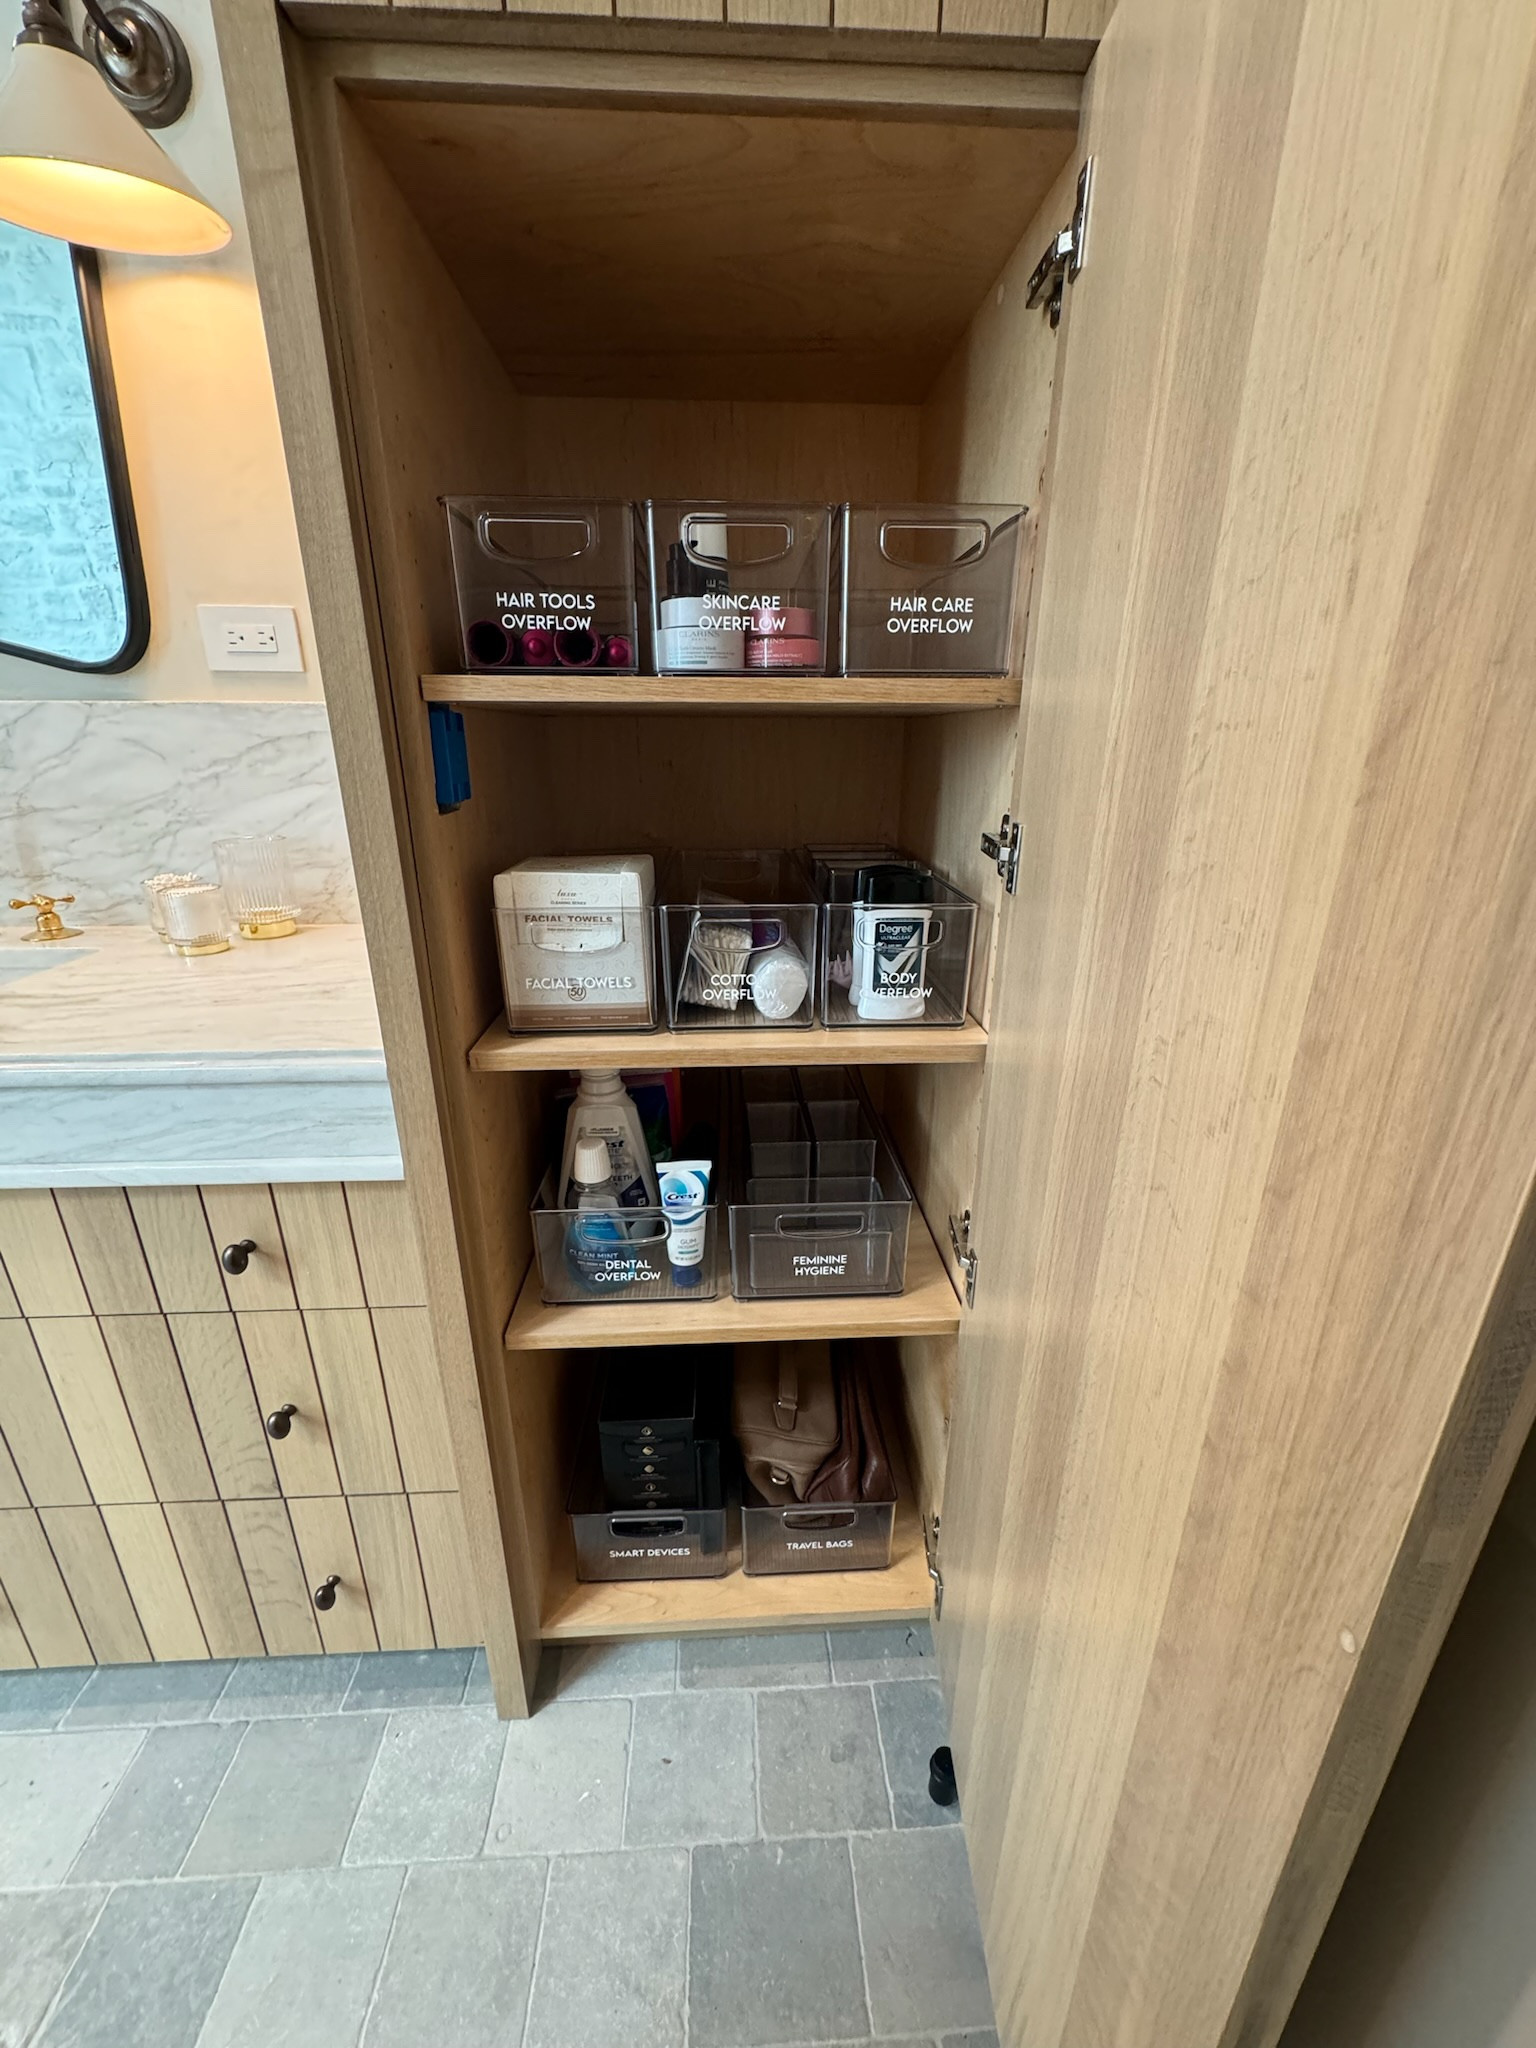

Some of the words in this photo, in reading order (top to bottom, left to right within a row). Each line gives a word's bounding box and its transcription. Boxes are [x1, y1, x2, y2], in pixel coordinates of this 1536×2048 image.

[496, 592, 535, 608] HAIR
[539, 593, 596, 610] TOOLS
[702, 594, 781, 611] SKINCARE
[890, 596, 927, 612] HAIR
[931, 597, 974, 613] CARE
[501, 614, 592, 631] OVERFLOW
[698, 616, 787, 631] OVERFLOW
[887, 618, 974, 633] OVERFLOW
[679, 630, 720, 638] CLARINS
[524, 914, 562, 923] FACIAL
[567, 914, 613, 923] TOWELS
[879, 924, 913, 935] Degree
[525, 977, 569, 990] FACIAL
[575, 976, 632, 989] TOWELS
[711, 974, 761, 986] COTTO
[881, 973, 917, 984] BODY
[570, 987, 584, 997] 50
[702, 988, 777, 1001] OVERFLOW
[868, 987, 933, 999] VERFLOW
[569, 1248, 596, 1259] CLEAN
[596, 1252, 619, 1260] MINT
[793, 1254, 848, 1265] FEMININE
[605, 1260, 652, 1269] DENTAL
[594, 1271, 661, 1281] OVERFLOW
[795, 1265, 845, 1276] HYGIENE
[786, 1541, 824, 1550] TRAVEL
[825, 1539, 854, 1549] BAGS
[609, 1549, 645, 1558] SMART
[647, 1547, 691, 1557] DEVICES
